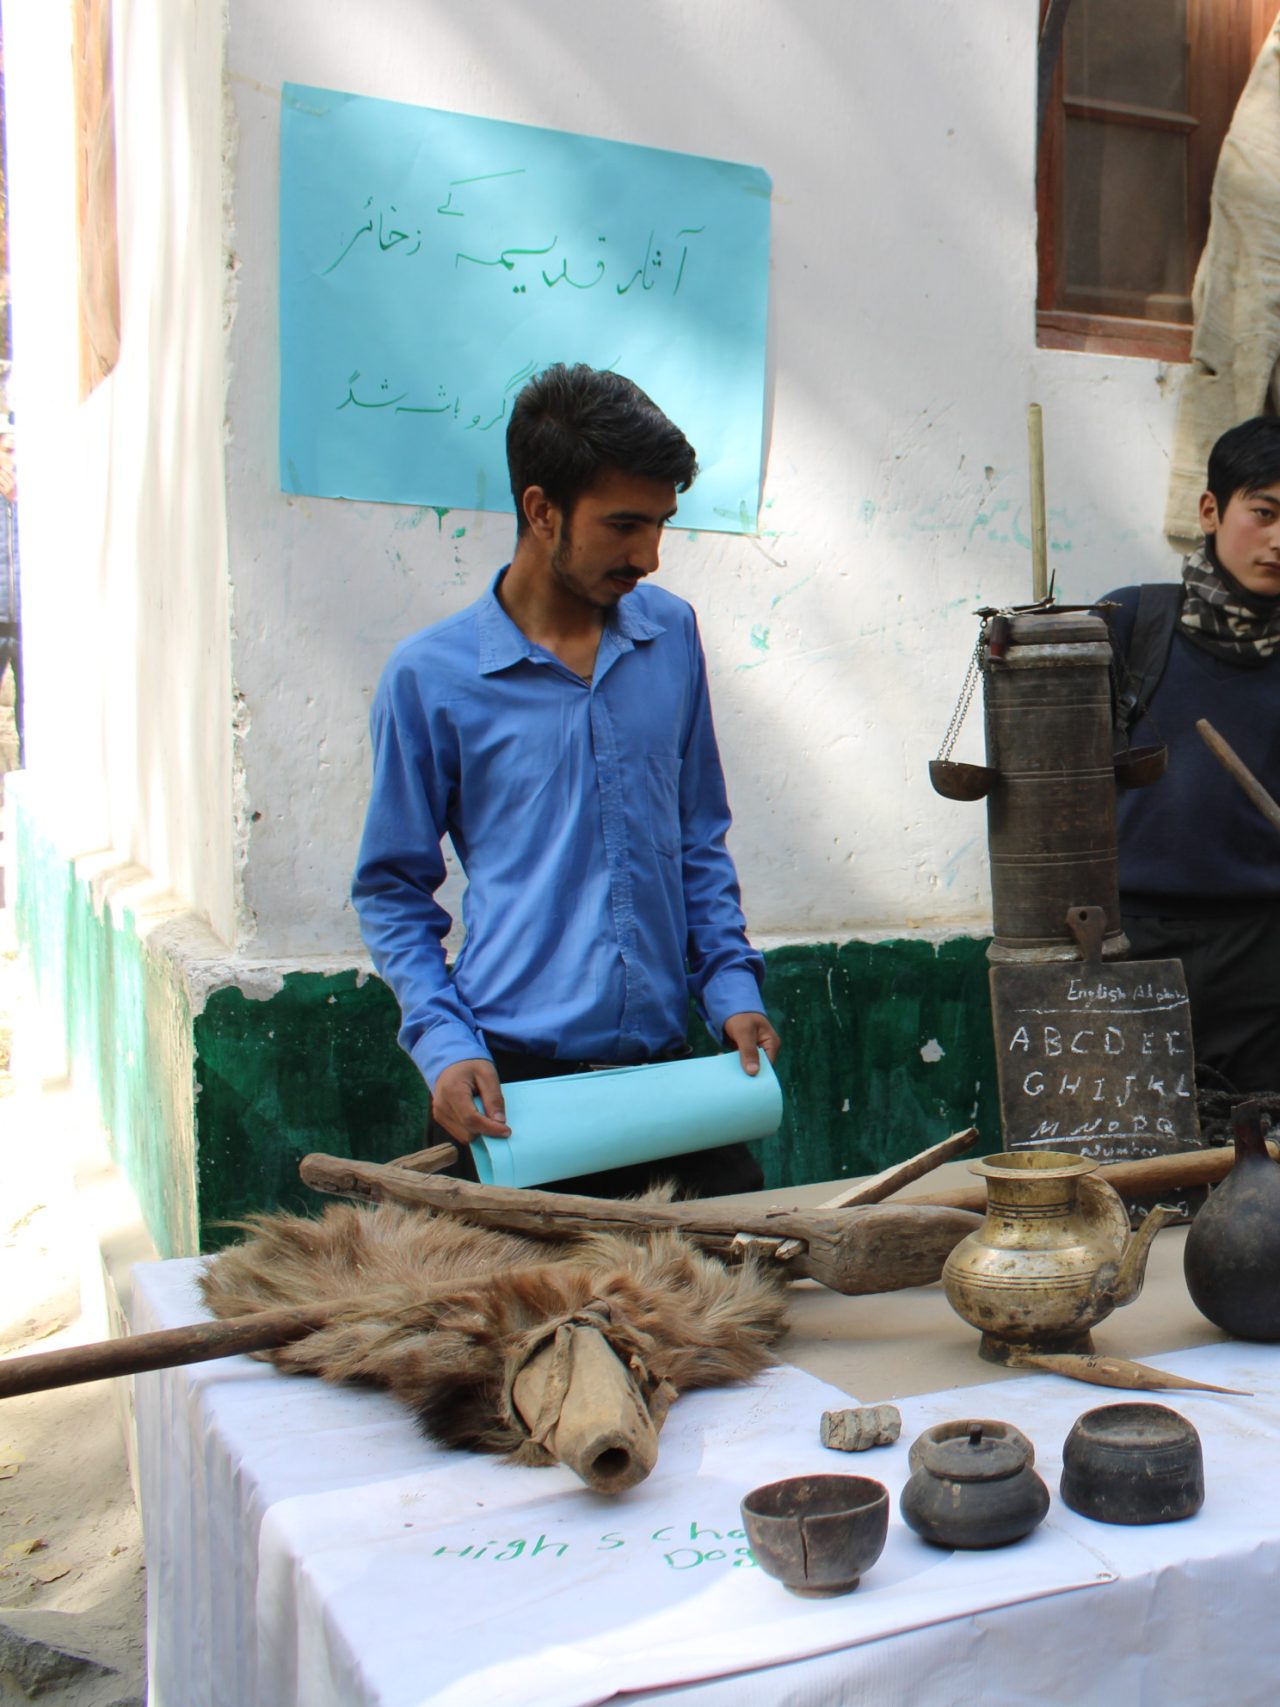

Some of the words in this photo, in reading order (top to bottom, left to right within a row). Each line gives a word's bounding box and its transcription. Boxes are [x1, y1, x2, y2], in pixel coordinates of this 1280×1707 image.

[1066, 979, 1127, 1008] English
[1009, 1025, 1030, 1052] A
[1044, 1026, 1063, 1056] B
[1070, 1030, 1095, 1054] C
[1104, 1026, 1126, 1055] D
[1141, 1032, 1156, 1055] E
[1023, 1071, 1045, 1096] G
[1058, 1074, 1081, 1095] H
[1092, 1077, 1106, 1101] I
[1116, 1075, 1137, 1107] J
[1147, 1074, 1167, 1096] K
[1175, 1073, 1191, 1097] L
[1030, 1120, 1061, 1138] M
[1070, 1117, 1103, 1136] N
[1132, 1115, 1148, 1133] P
[1156, 1117, 1176, 1136] Q
[431, 1533, 570, 1562] High
[664, 1547, 758, 1570] Dog
